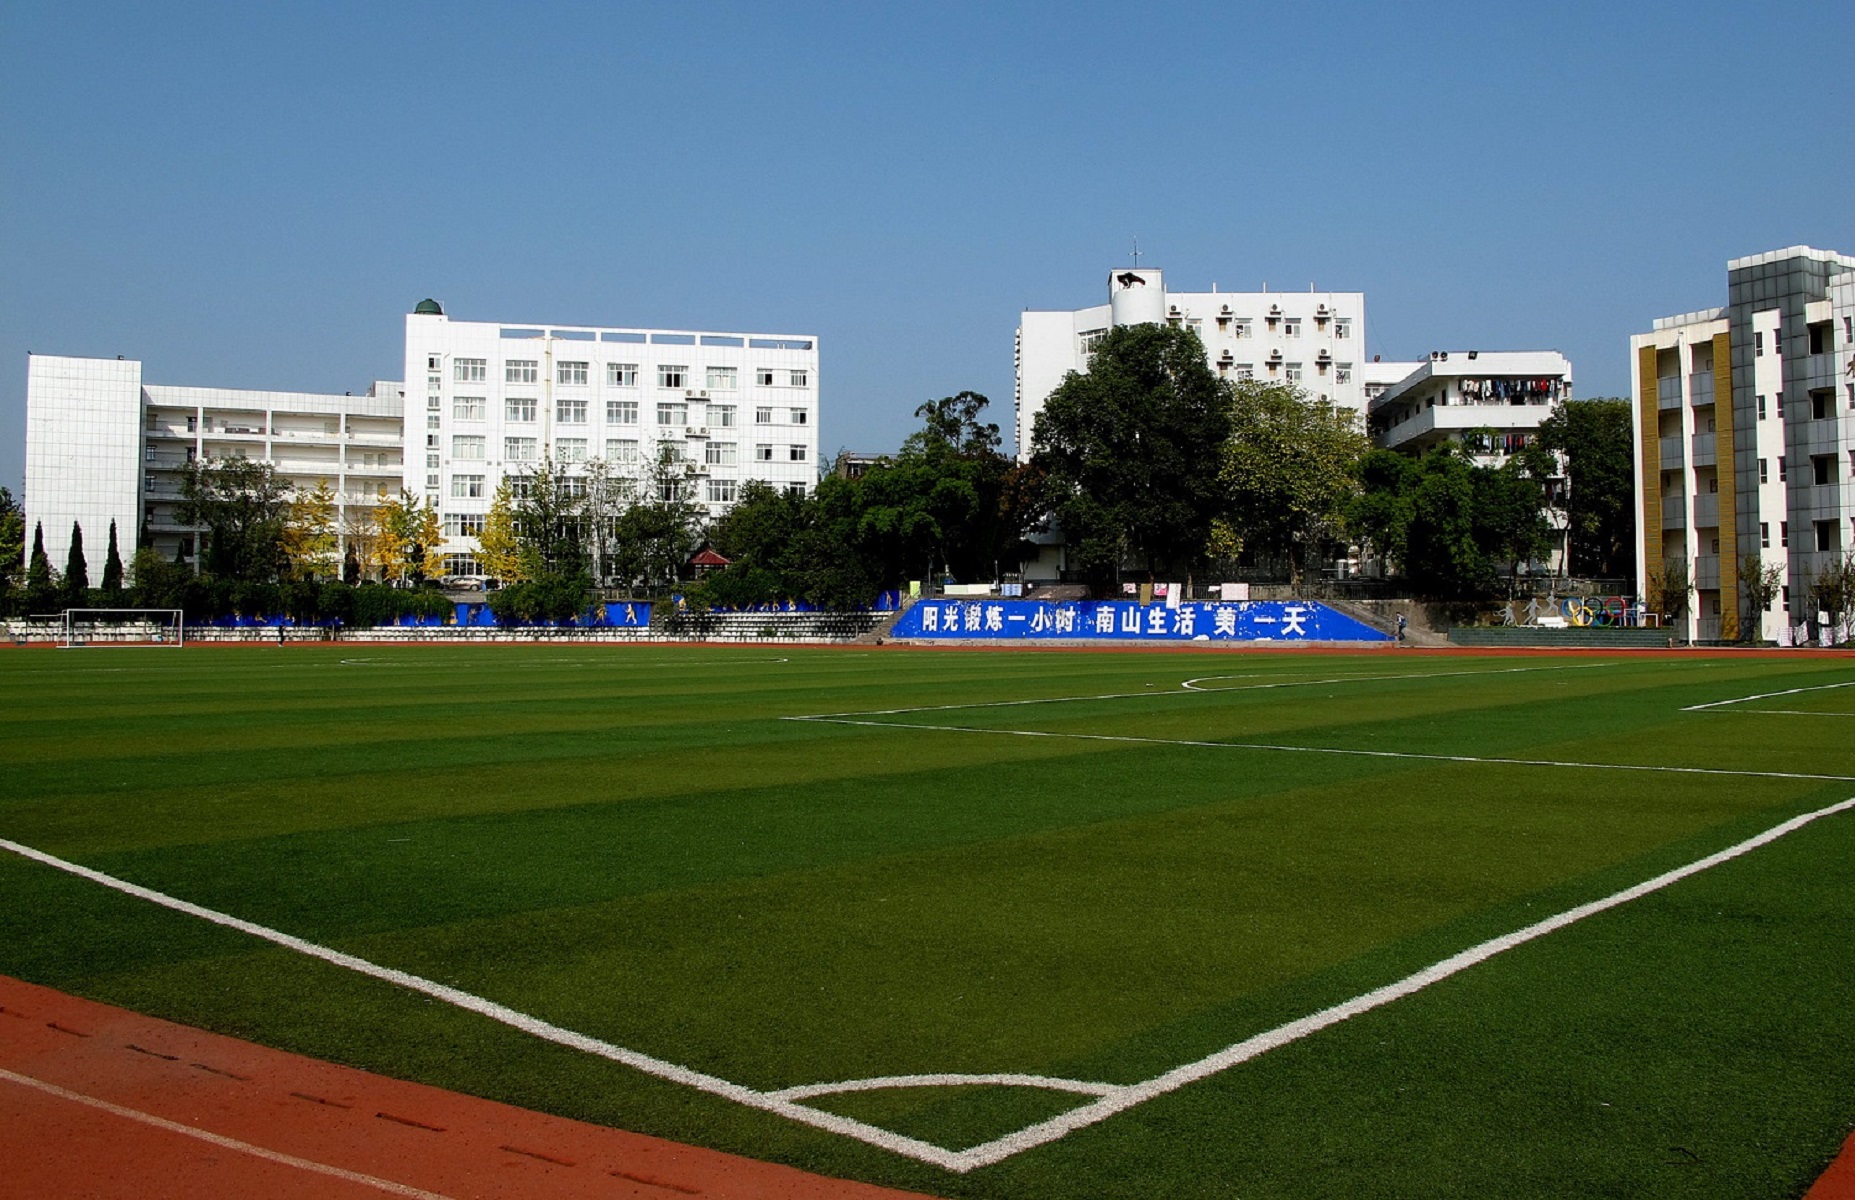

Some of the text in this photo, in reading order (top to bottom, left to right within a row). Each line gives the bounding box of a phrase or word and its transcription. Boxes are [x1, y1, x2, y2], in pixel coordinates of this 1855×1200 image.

[922, 605, 1076, 633] 阳光锻炼一小时
